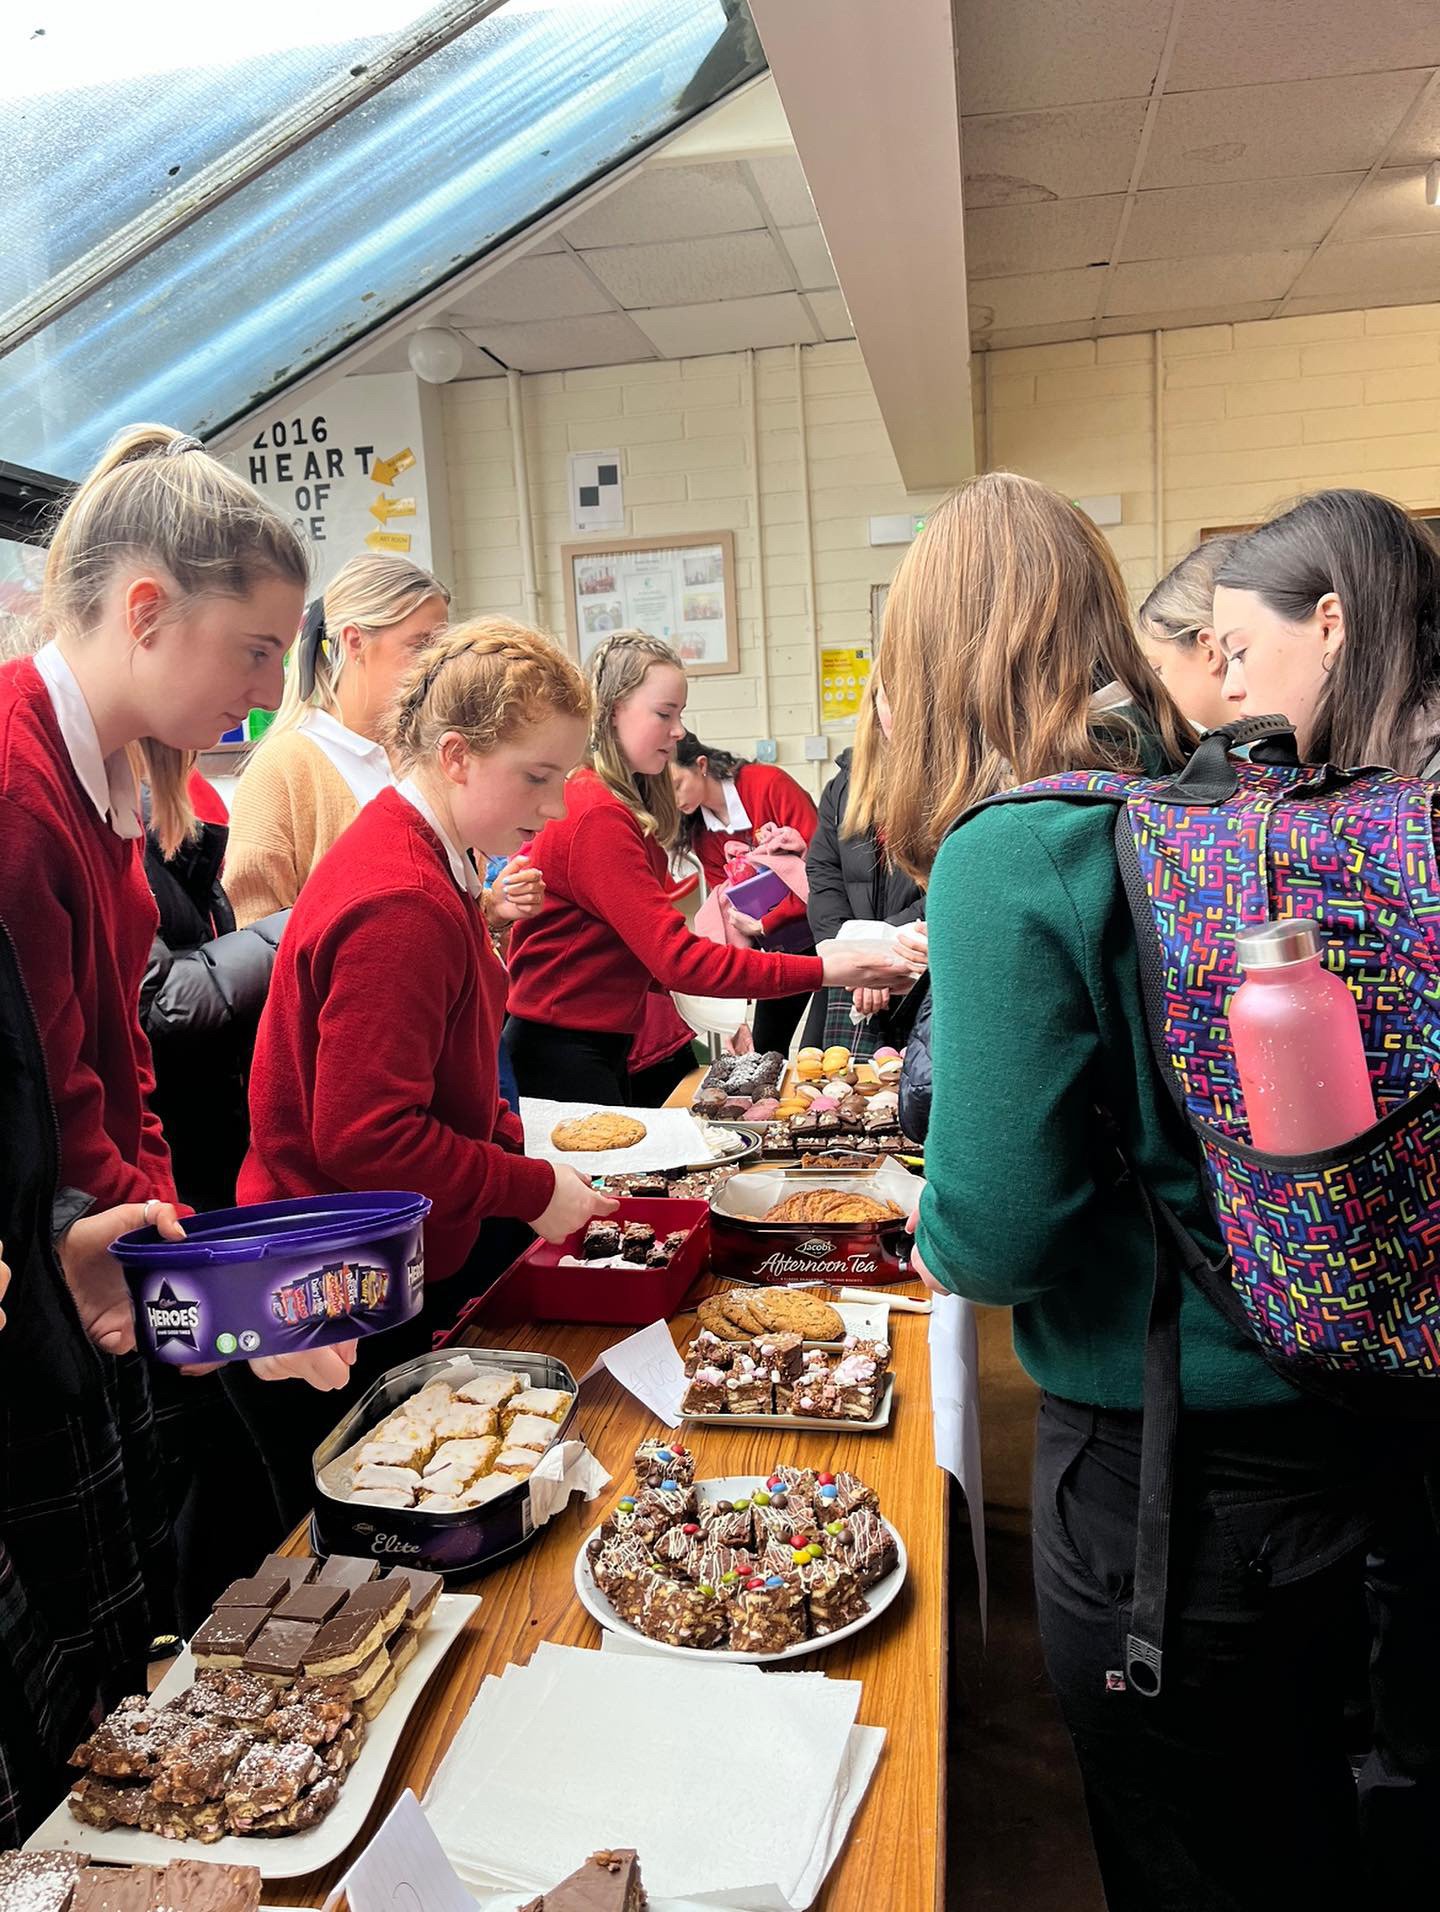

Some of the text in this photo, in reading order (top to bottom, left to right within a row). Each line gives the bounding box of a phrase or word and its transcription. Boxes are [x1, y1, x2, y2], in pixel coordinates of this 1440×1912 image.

[249, 446, 374, 484] HEART
[295, 484, 331, 511] OF
[752, 1252, 878, 1277] Afternoon Tea
[147, 1306, 199, 1328] HEROES
[371, 1533, 422, 1554] Elite
